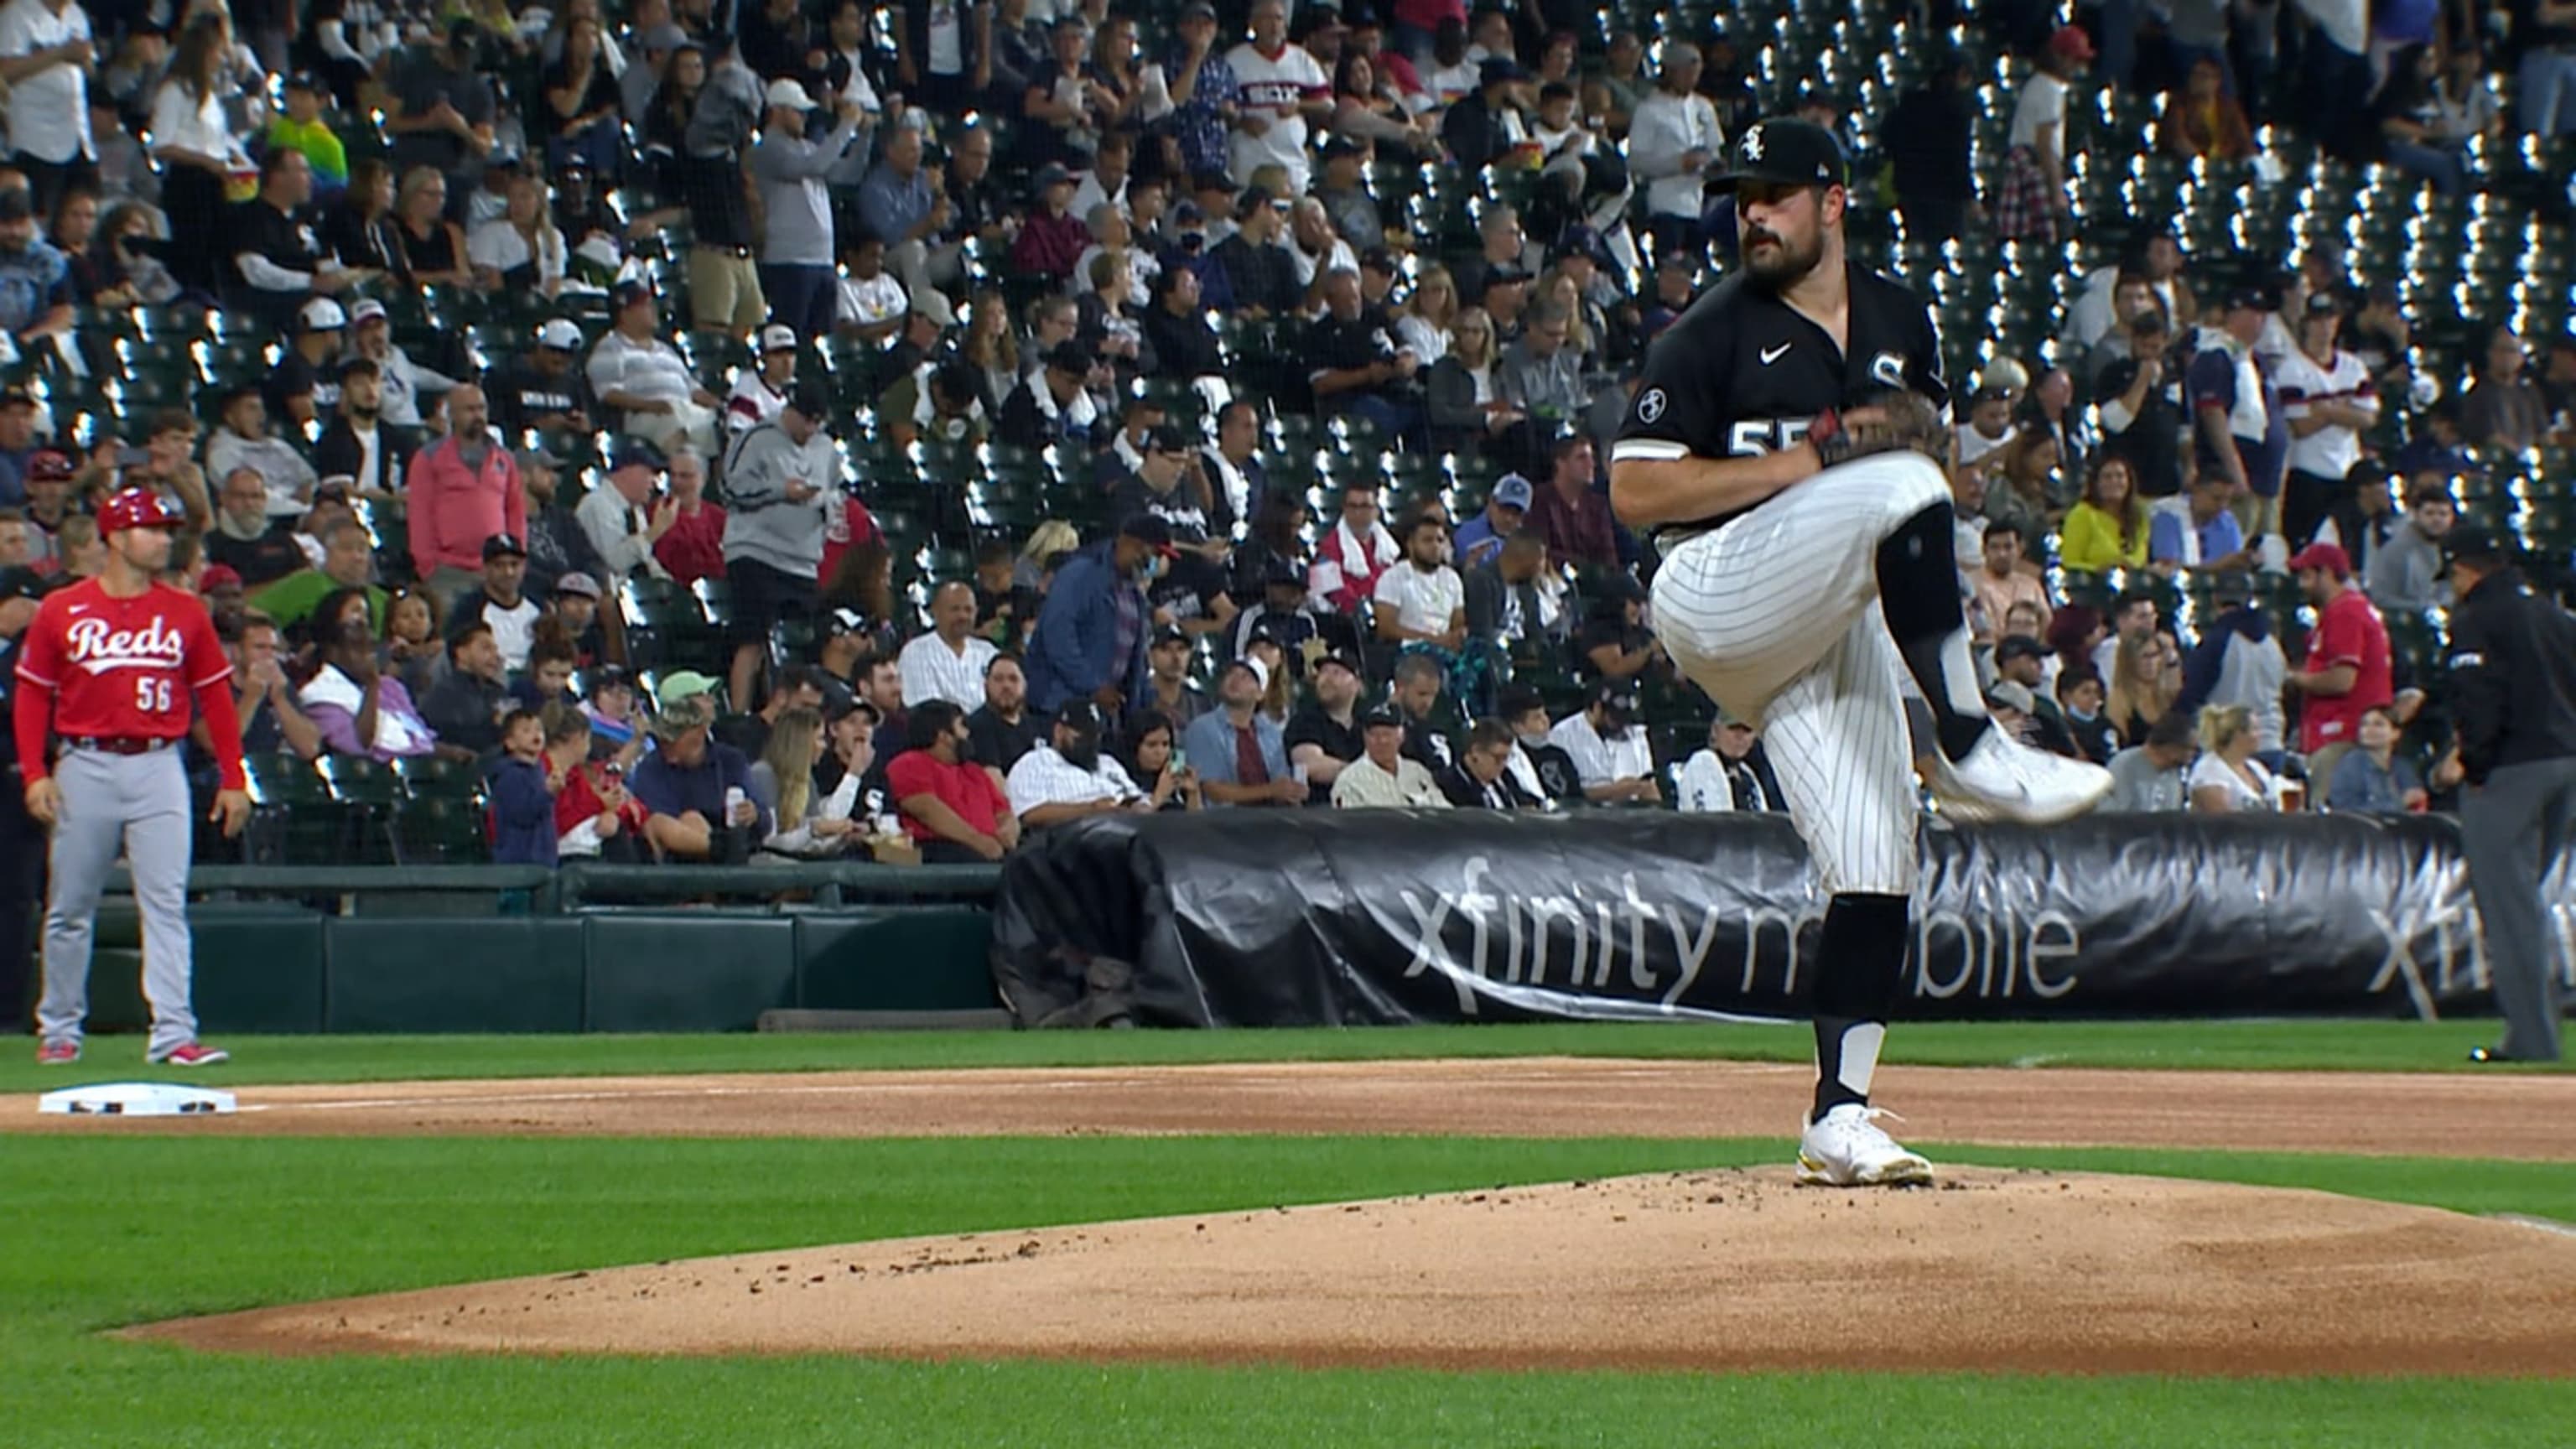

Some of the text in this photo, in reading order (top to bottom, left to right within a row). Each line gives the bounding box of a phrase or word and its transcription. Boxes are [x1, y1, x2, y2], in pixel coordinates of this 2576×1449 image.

[66, 614, 184, 676] Reds
[136, 676, 172, 711] 56
[1400, 856, 2080, 1014] xfinity mbile
